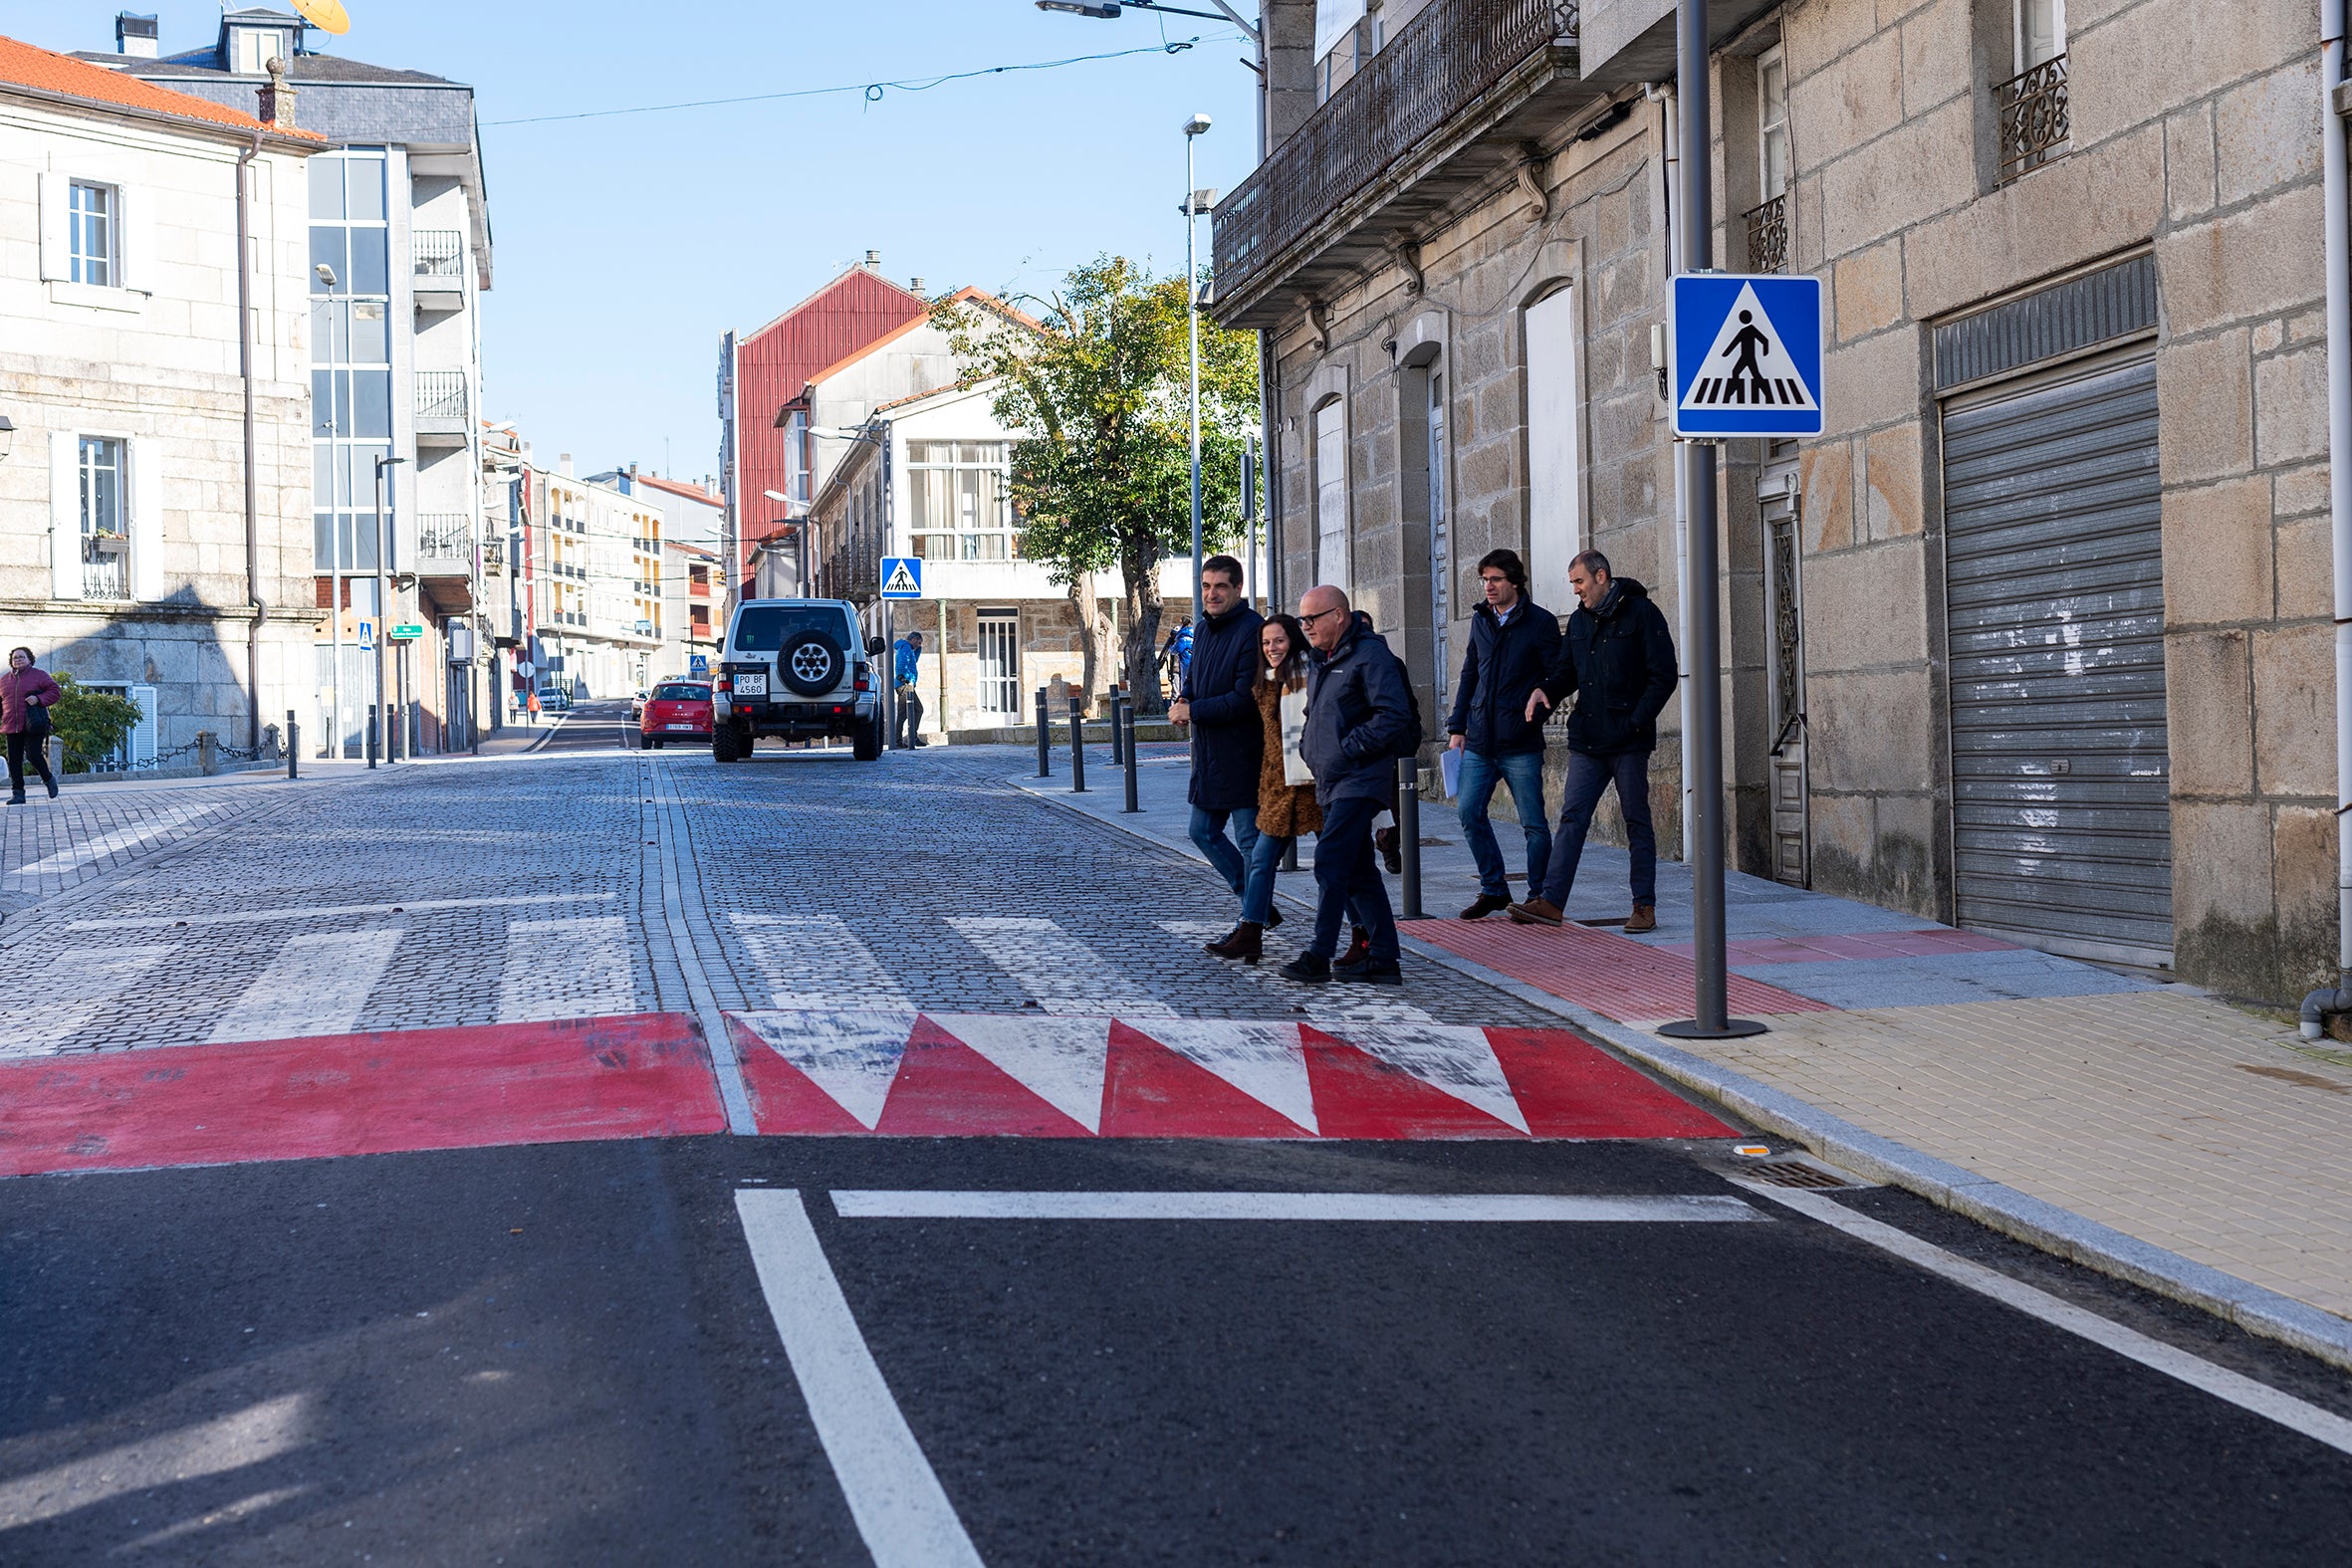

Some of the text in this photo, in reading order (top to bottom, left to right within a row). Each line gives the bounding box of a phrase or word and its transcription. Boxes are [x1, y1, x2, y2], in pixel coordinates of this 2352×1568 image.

[740, 675, 764, 684] PO BF
[740, 685, 762, 694] 4560
